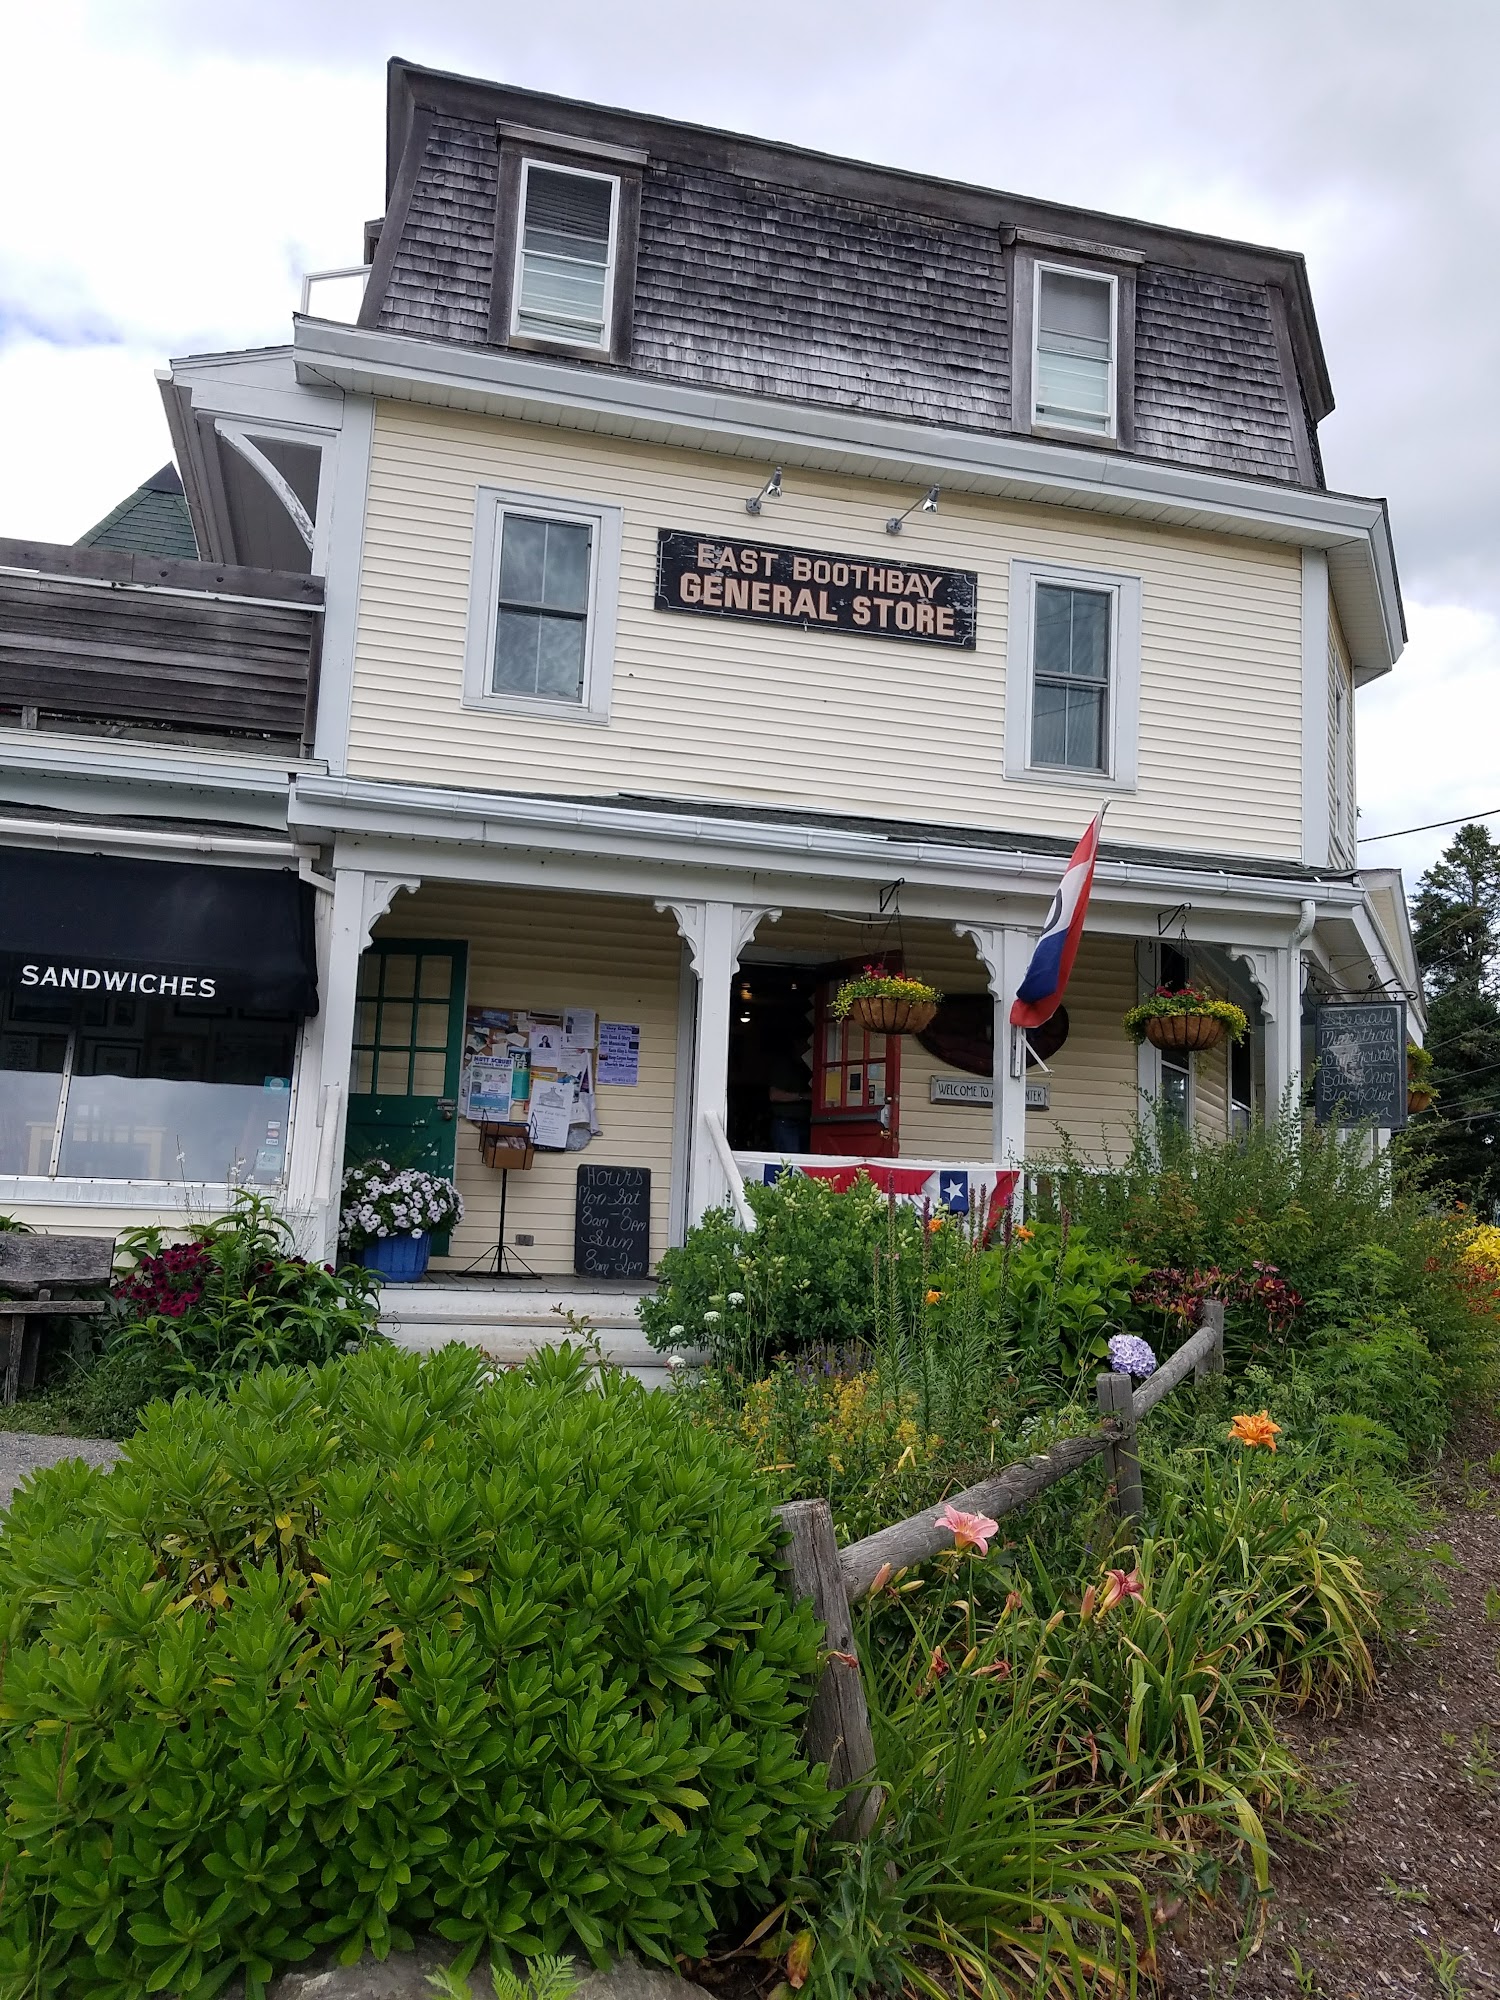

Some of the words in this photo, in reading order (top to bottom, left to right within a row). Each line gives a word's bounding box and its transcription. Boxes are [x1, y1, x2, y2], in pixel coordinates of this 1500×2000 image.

[697, 543, 778, 576] EAST
[792, 557, 942, 599] BOOTHBAY
[680, 572, 838, 622] GENERAL
[852, 596, 955, 637] STORE
[20, 965, 217, 998] SANDWICHES
[938, 1083, 978, 1097] WELCOME
[980, 1086, 989, 1098] TO
[587, 1166, 643, 1186] Hours
[581, 1229, 634, 1250] Sun
